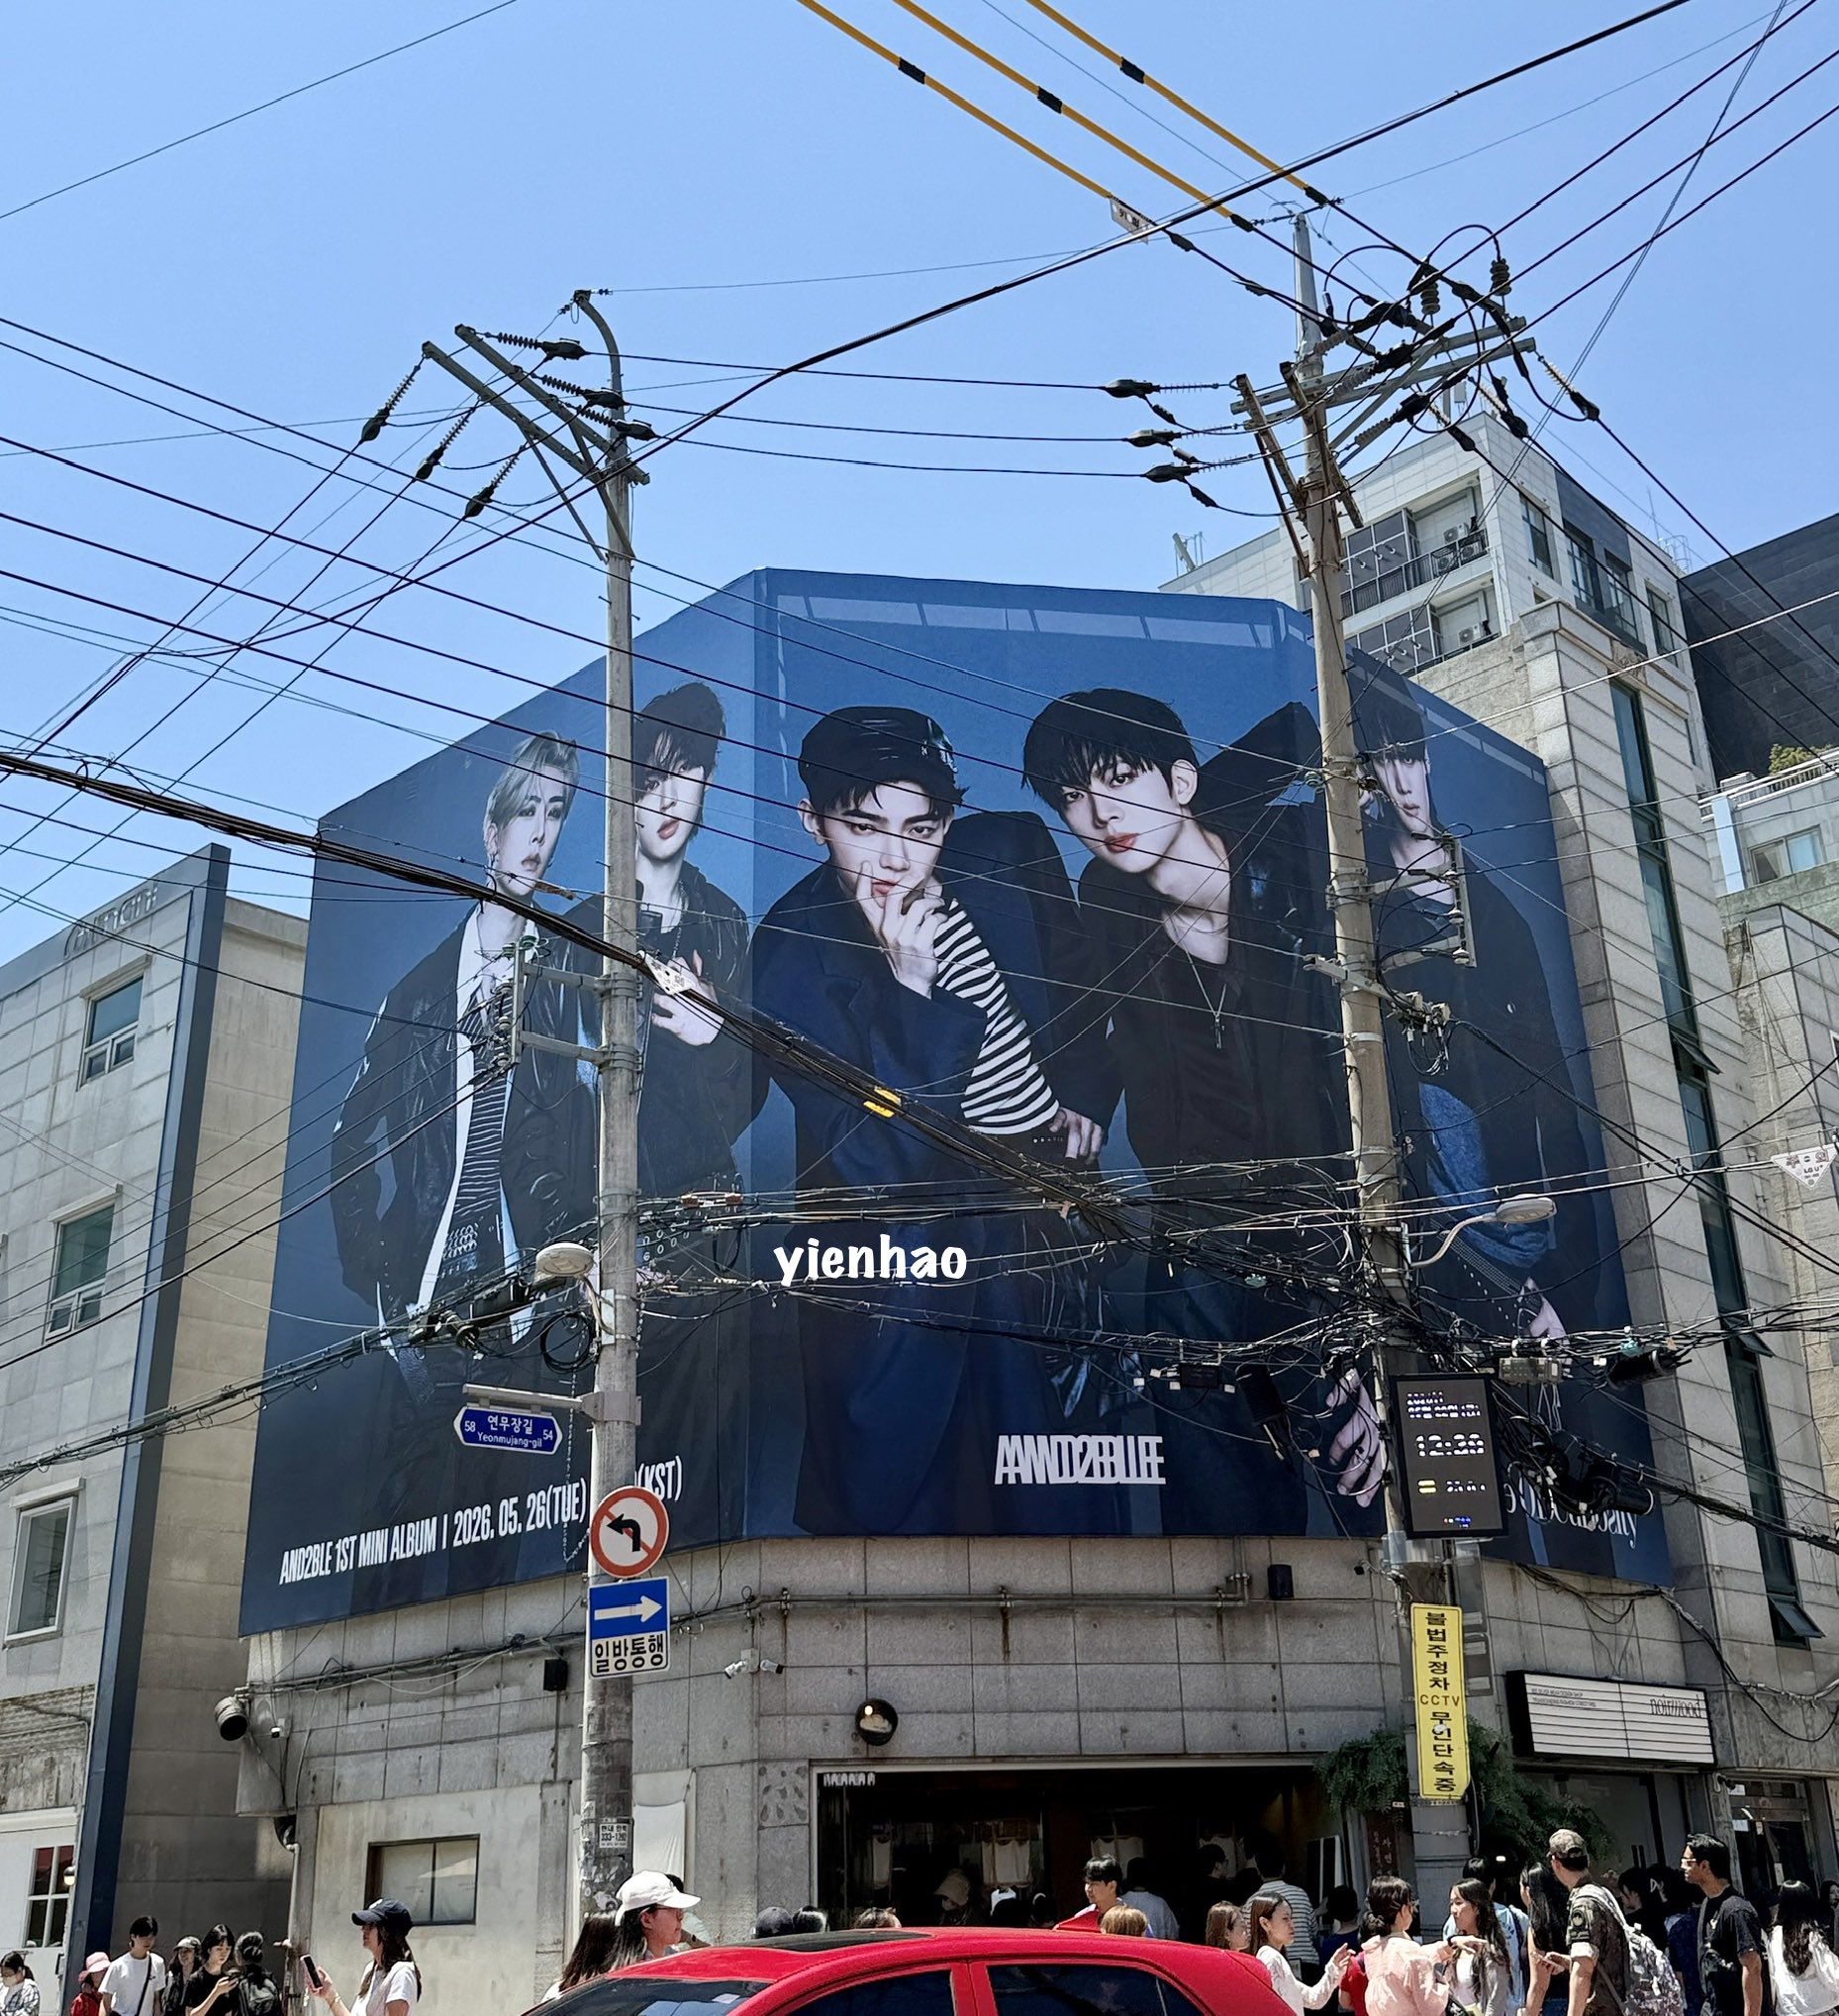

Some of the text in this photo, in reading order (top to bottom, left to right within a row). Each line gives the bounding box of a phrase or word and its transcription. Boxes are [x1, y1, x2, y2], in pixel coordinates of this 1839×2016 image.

[464, 1420, 476, 1433] 58
[487, 1415, 532, 1435] 연무장길
[542, 1429, 553, 1441] 54
[477, 1431, 542, 1449] Yeonmujang-gil
[279, 1541, 334, 1585] AND2BLE
[335, 1535, 357, 1574] 1ST
[358, 1528, 389, 1568] MINI
[389, 1515, 437, 1562] ALBUM
[452, 1504, 495, 1547] 2026.
[498, 1496, 523, 1537] 05.
[527, 1478, 587, 1532] 26(TUE)
[595, 1633, 664, 1674] 일방통행
[1425, 1612, 1450, 1691] 불법주정차
[1419, 1693, 1460, 1707] CCTV
[1429, 1711, 1457, 1792] 무인단속중
